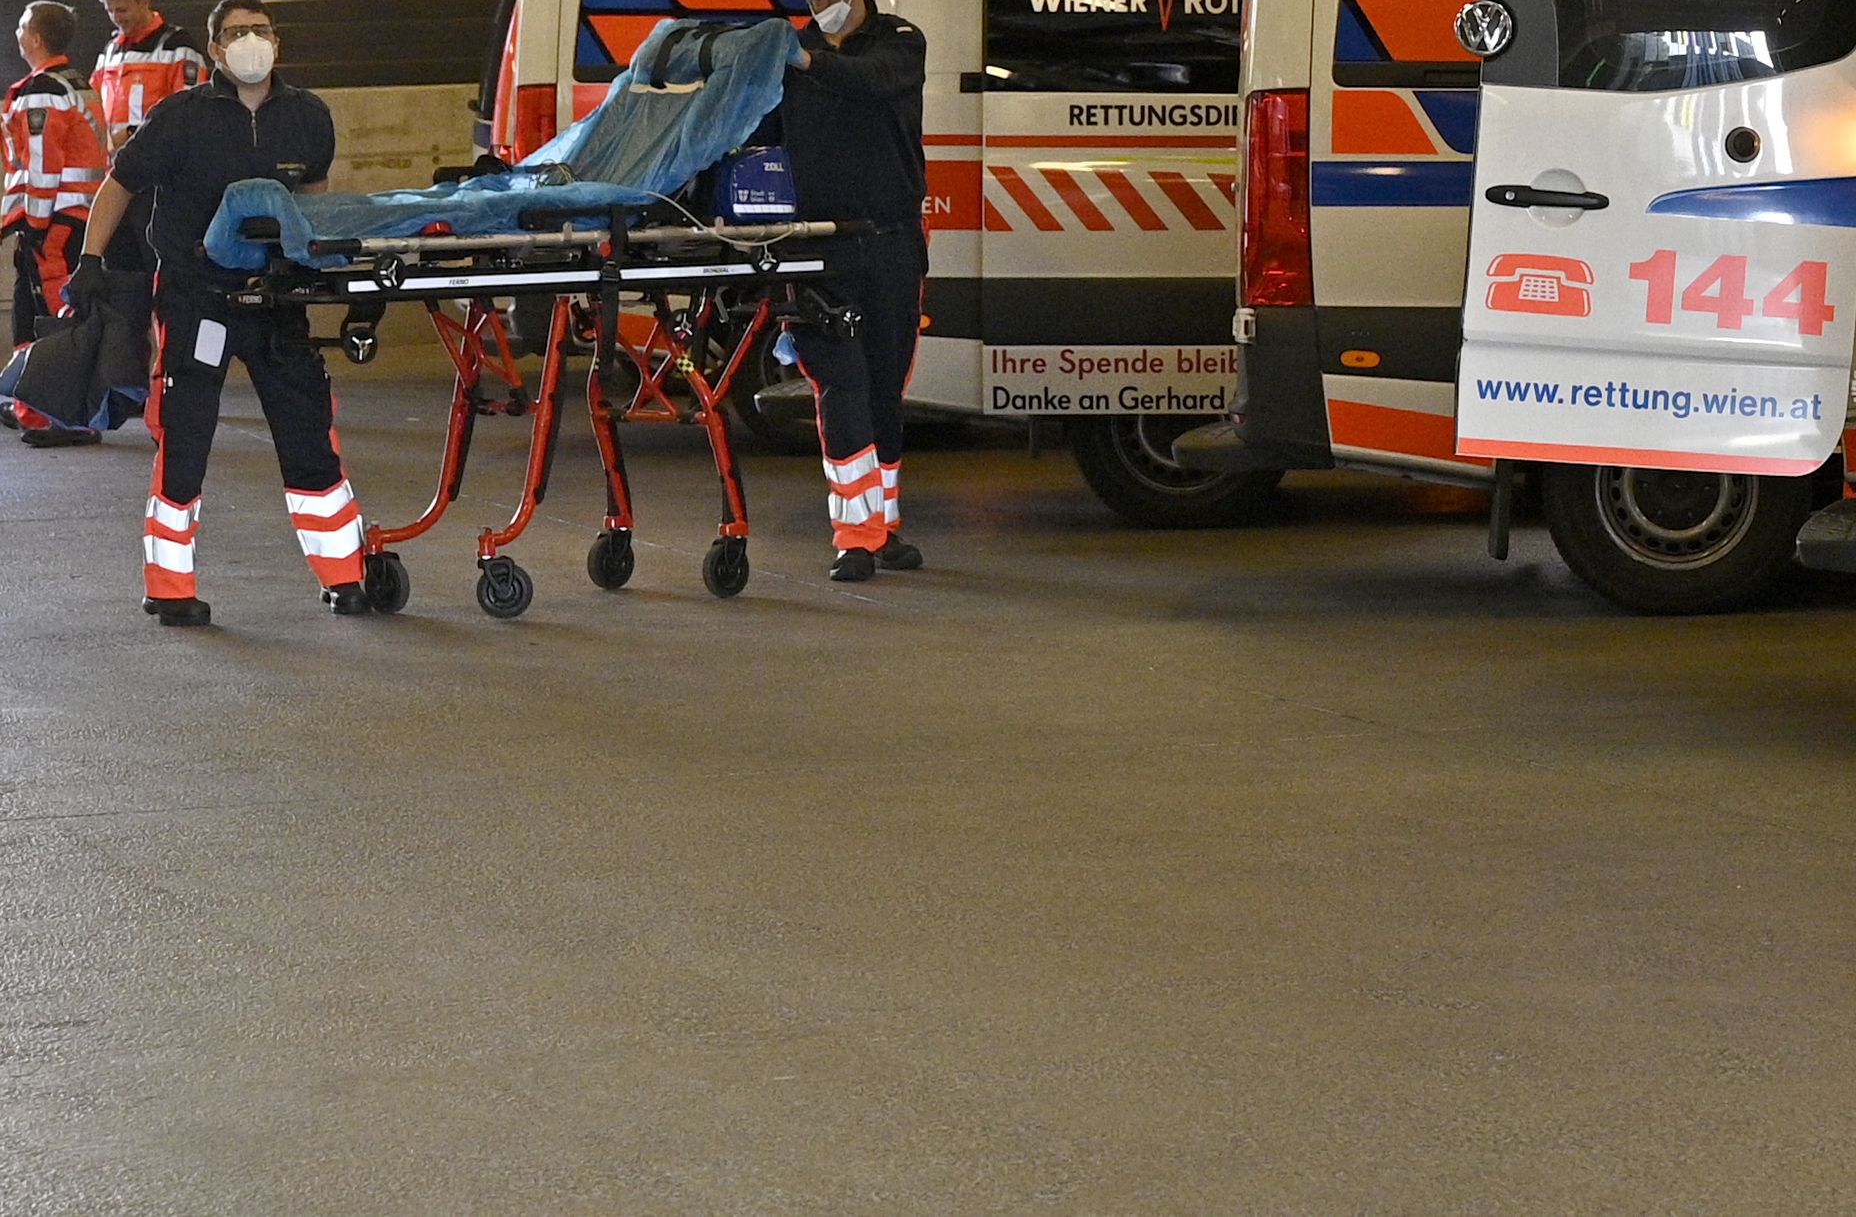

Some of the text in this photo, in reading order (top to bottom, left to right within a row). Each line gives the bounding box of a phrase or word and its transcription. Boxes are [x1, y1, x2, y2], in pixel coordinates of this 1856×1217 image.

[763, 162, 784, 172] ZOLL
[1629, 249, 1835, 336] 144
[992, 349, 1046, 373] Ihre
[1059, 349, 1164, 380] Spende
[992, 386, 1225, 410] Danke an Gerhard
[1476, 378, 1822, 421] www.rettung.wien.at
